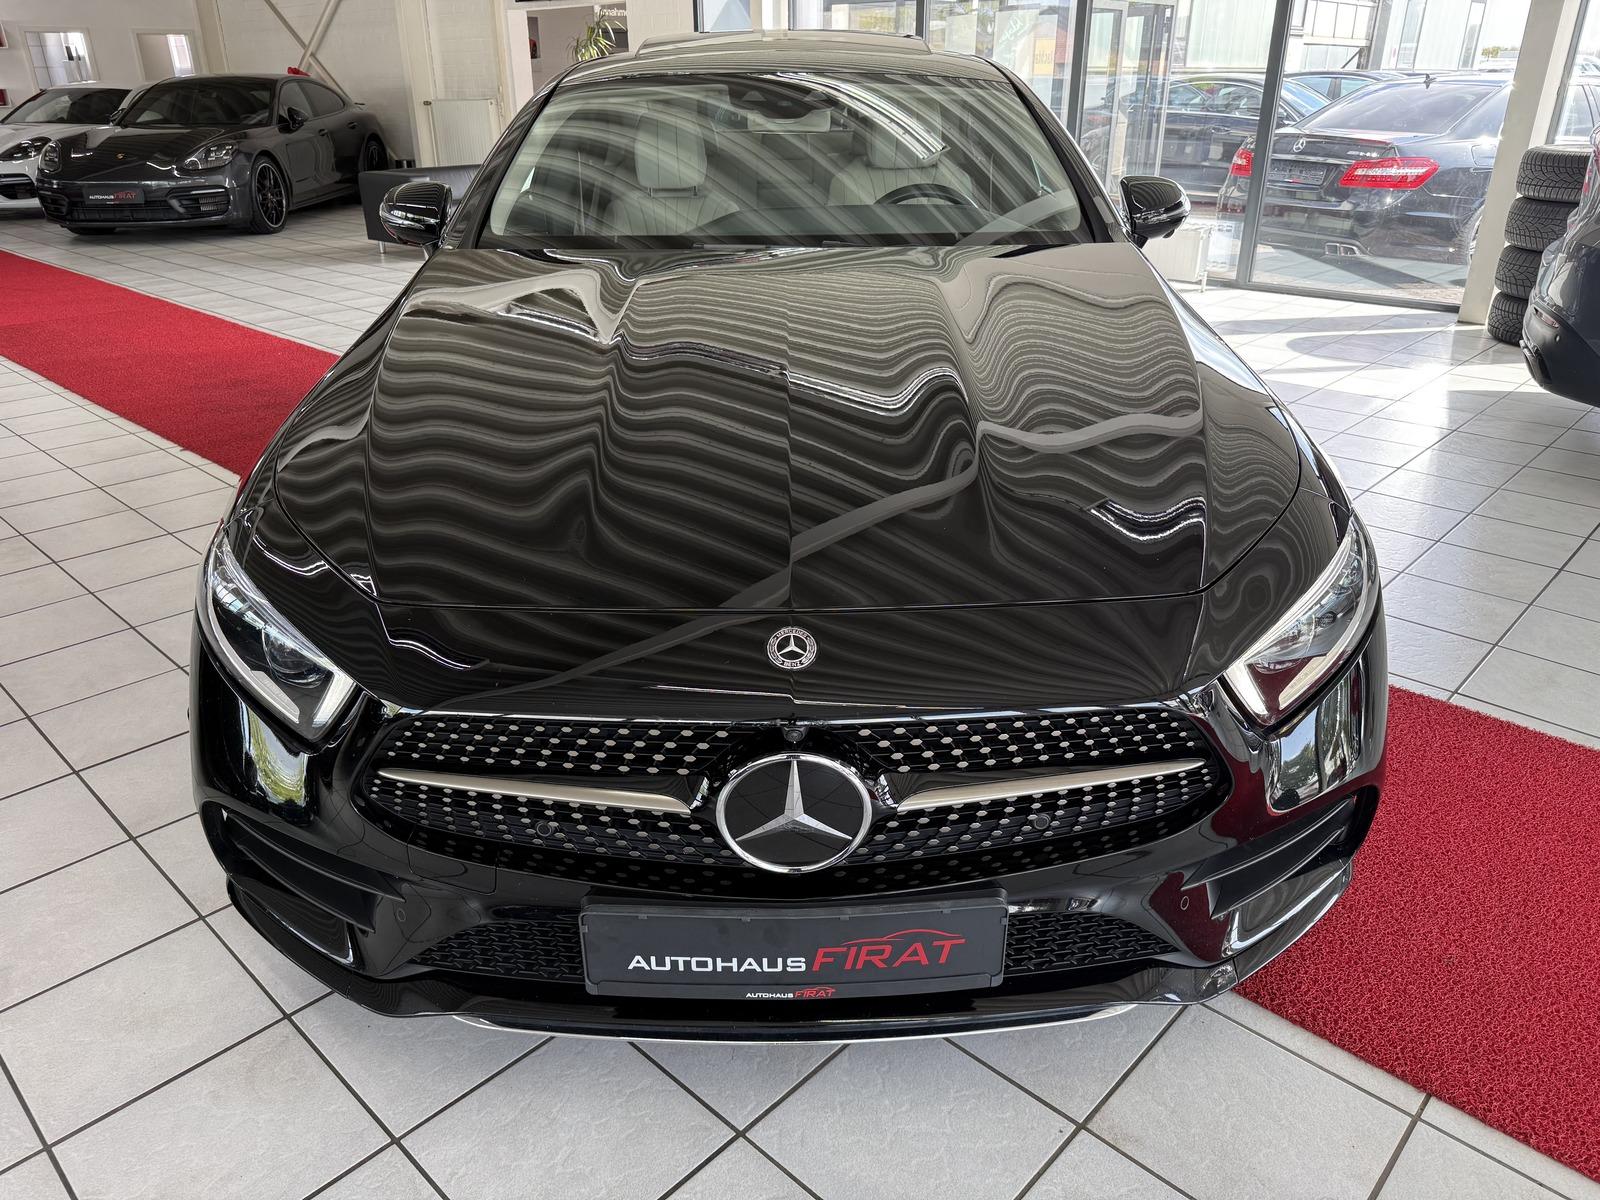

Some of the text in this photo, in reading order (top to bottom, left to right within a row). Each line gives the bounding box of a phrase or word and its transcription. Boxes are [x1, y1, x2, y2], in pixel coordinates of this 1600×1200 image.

[627, 938, 966, 972] AUTOHAUS FIRAT
[795, 989, 836, 998] FIRAT
